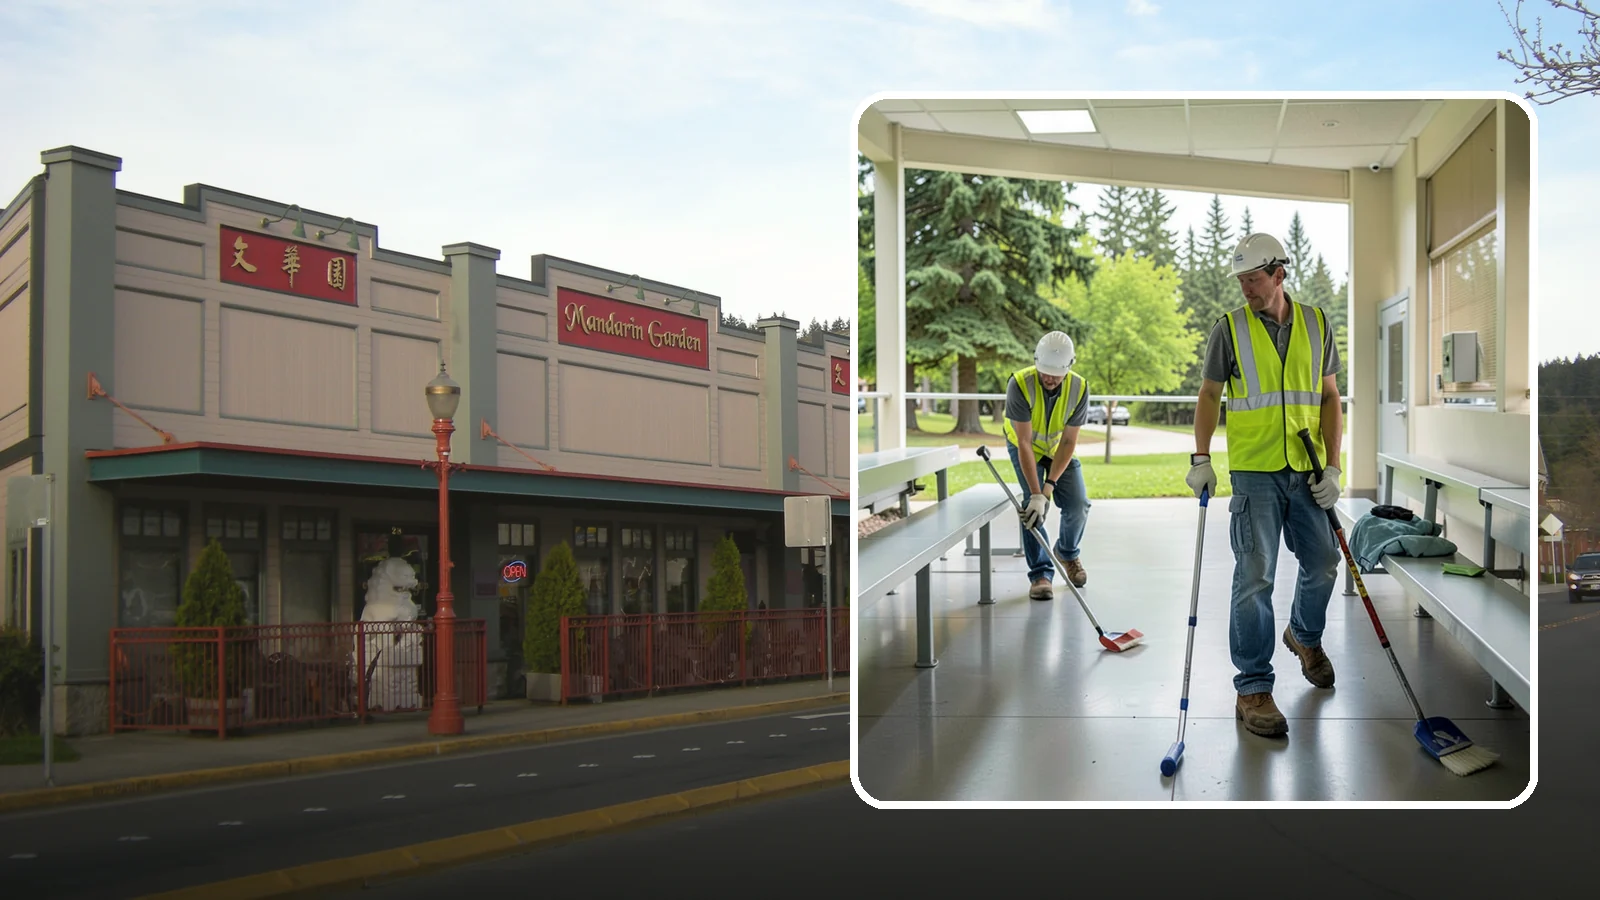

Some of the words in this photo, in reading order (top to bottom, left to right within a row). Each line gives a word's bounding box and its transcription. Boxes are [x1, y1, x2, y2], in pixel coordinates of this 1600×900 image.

[231, 236, 346, 290] 文華園
[564, 302, 644, 340] Mandarin
[648, 320, 701, 352] Garden
[503, 565, 527, 578] OPEN
